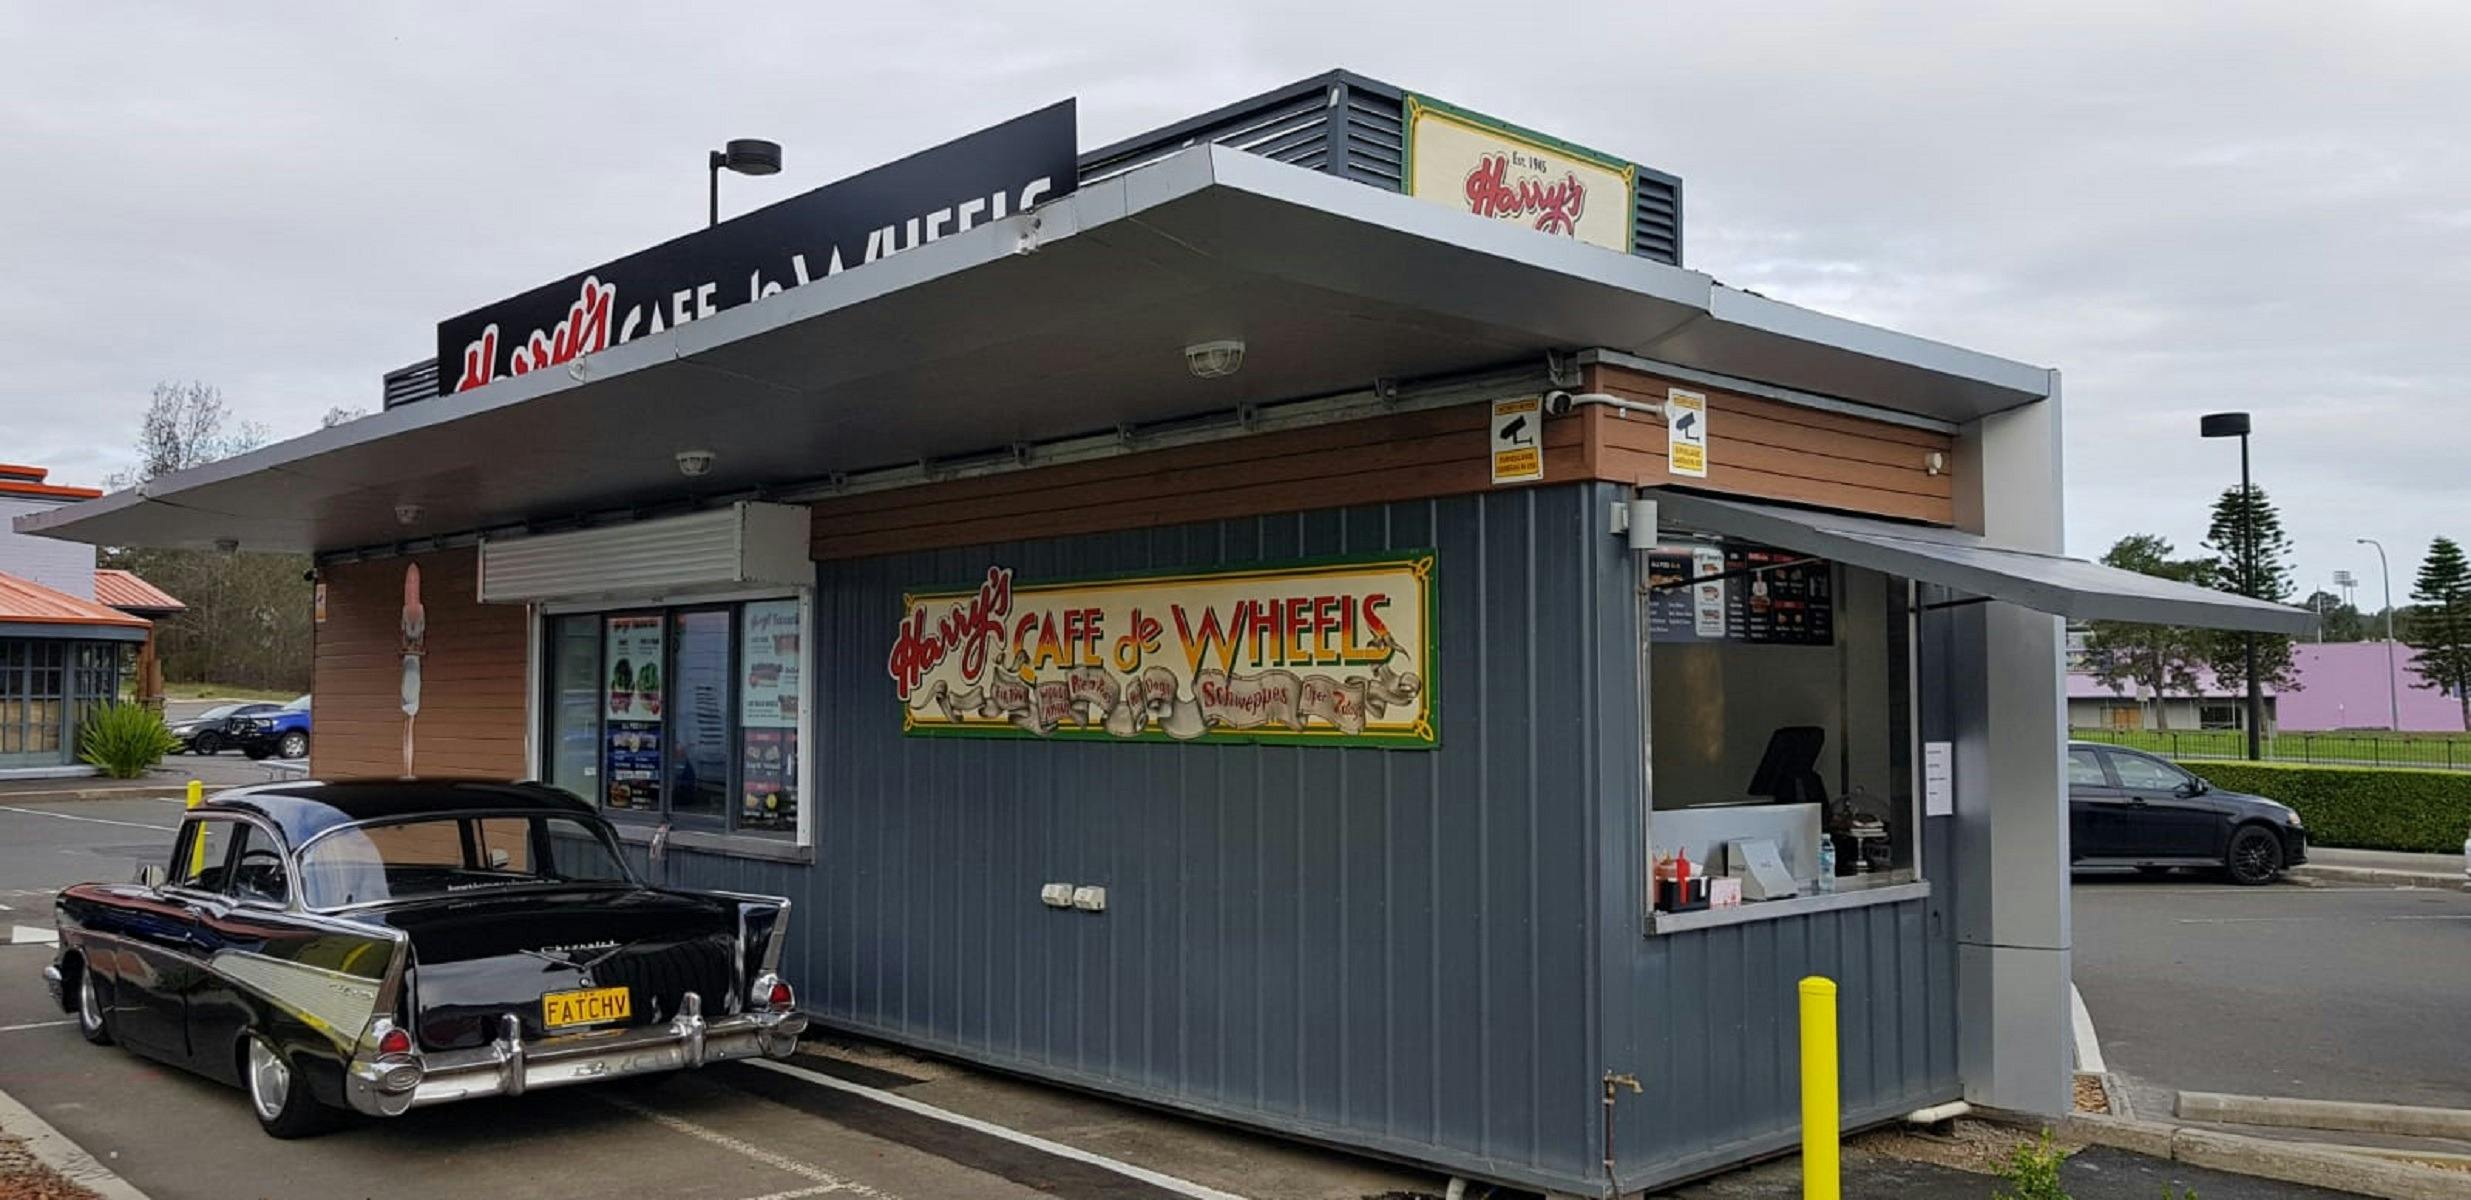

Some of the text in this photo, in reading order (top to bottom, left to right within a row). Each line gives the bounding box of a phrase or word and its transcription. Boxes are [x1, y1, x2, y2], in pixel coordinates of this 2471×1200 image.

[1464, 152, 1586, 237] Harry's
[890, 566, 1396, 699] Harry's CAFE de WHEELS
[1202, 680, 1289, 715] Schweppes
[547, 994, 626, 1023] FATCHV
